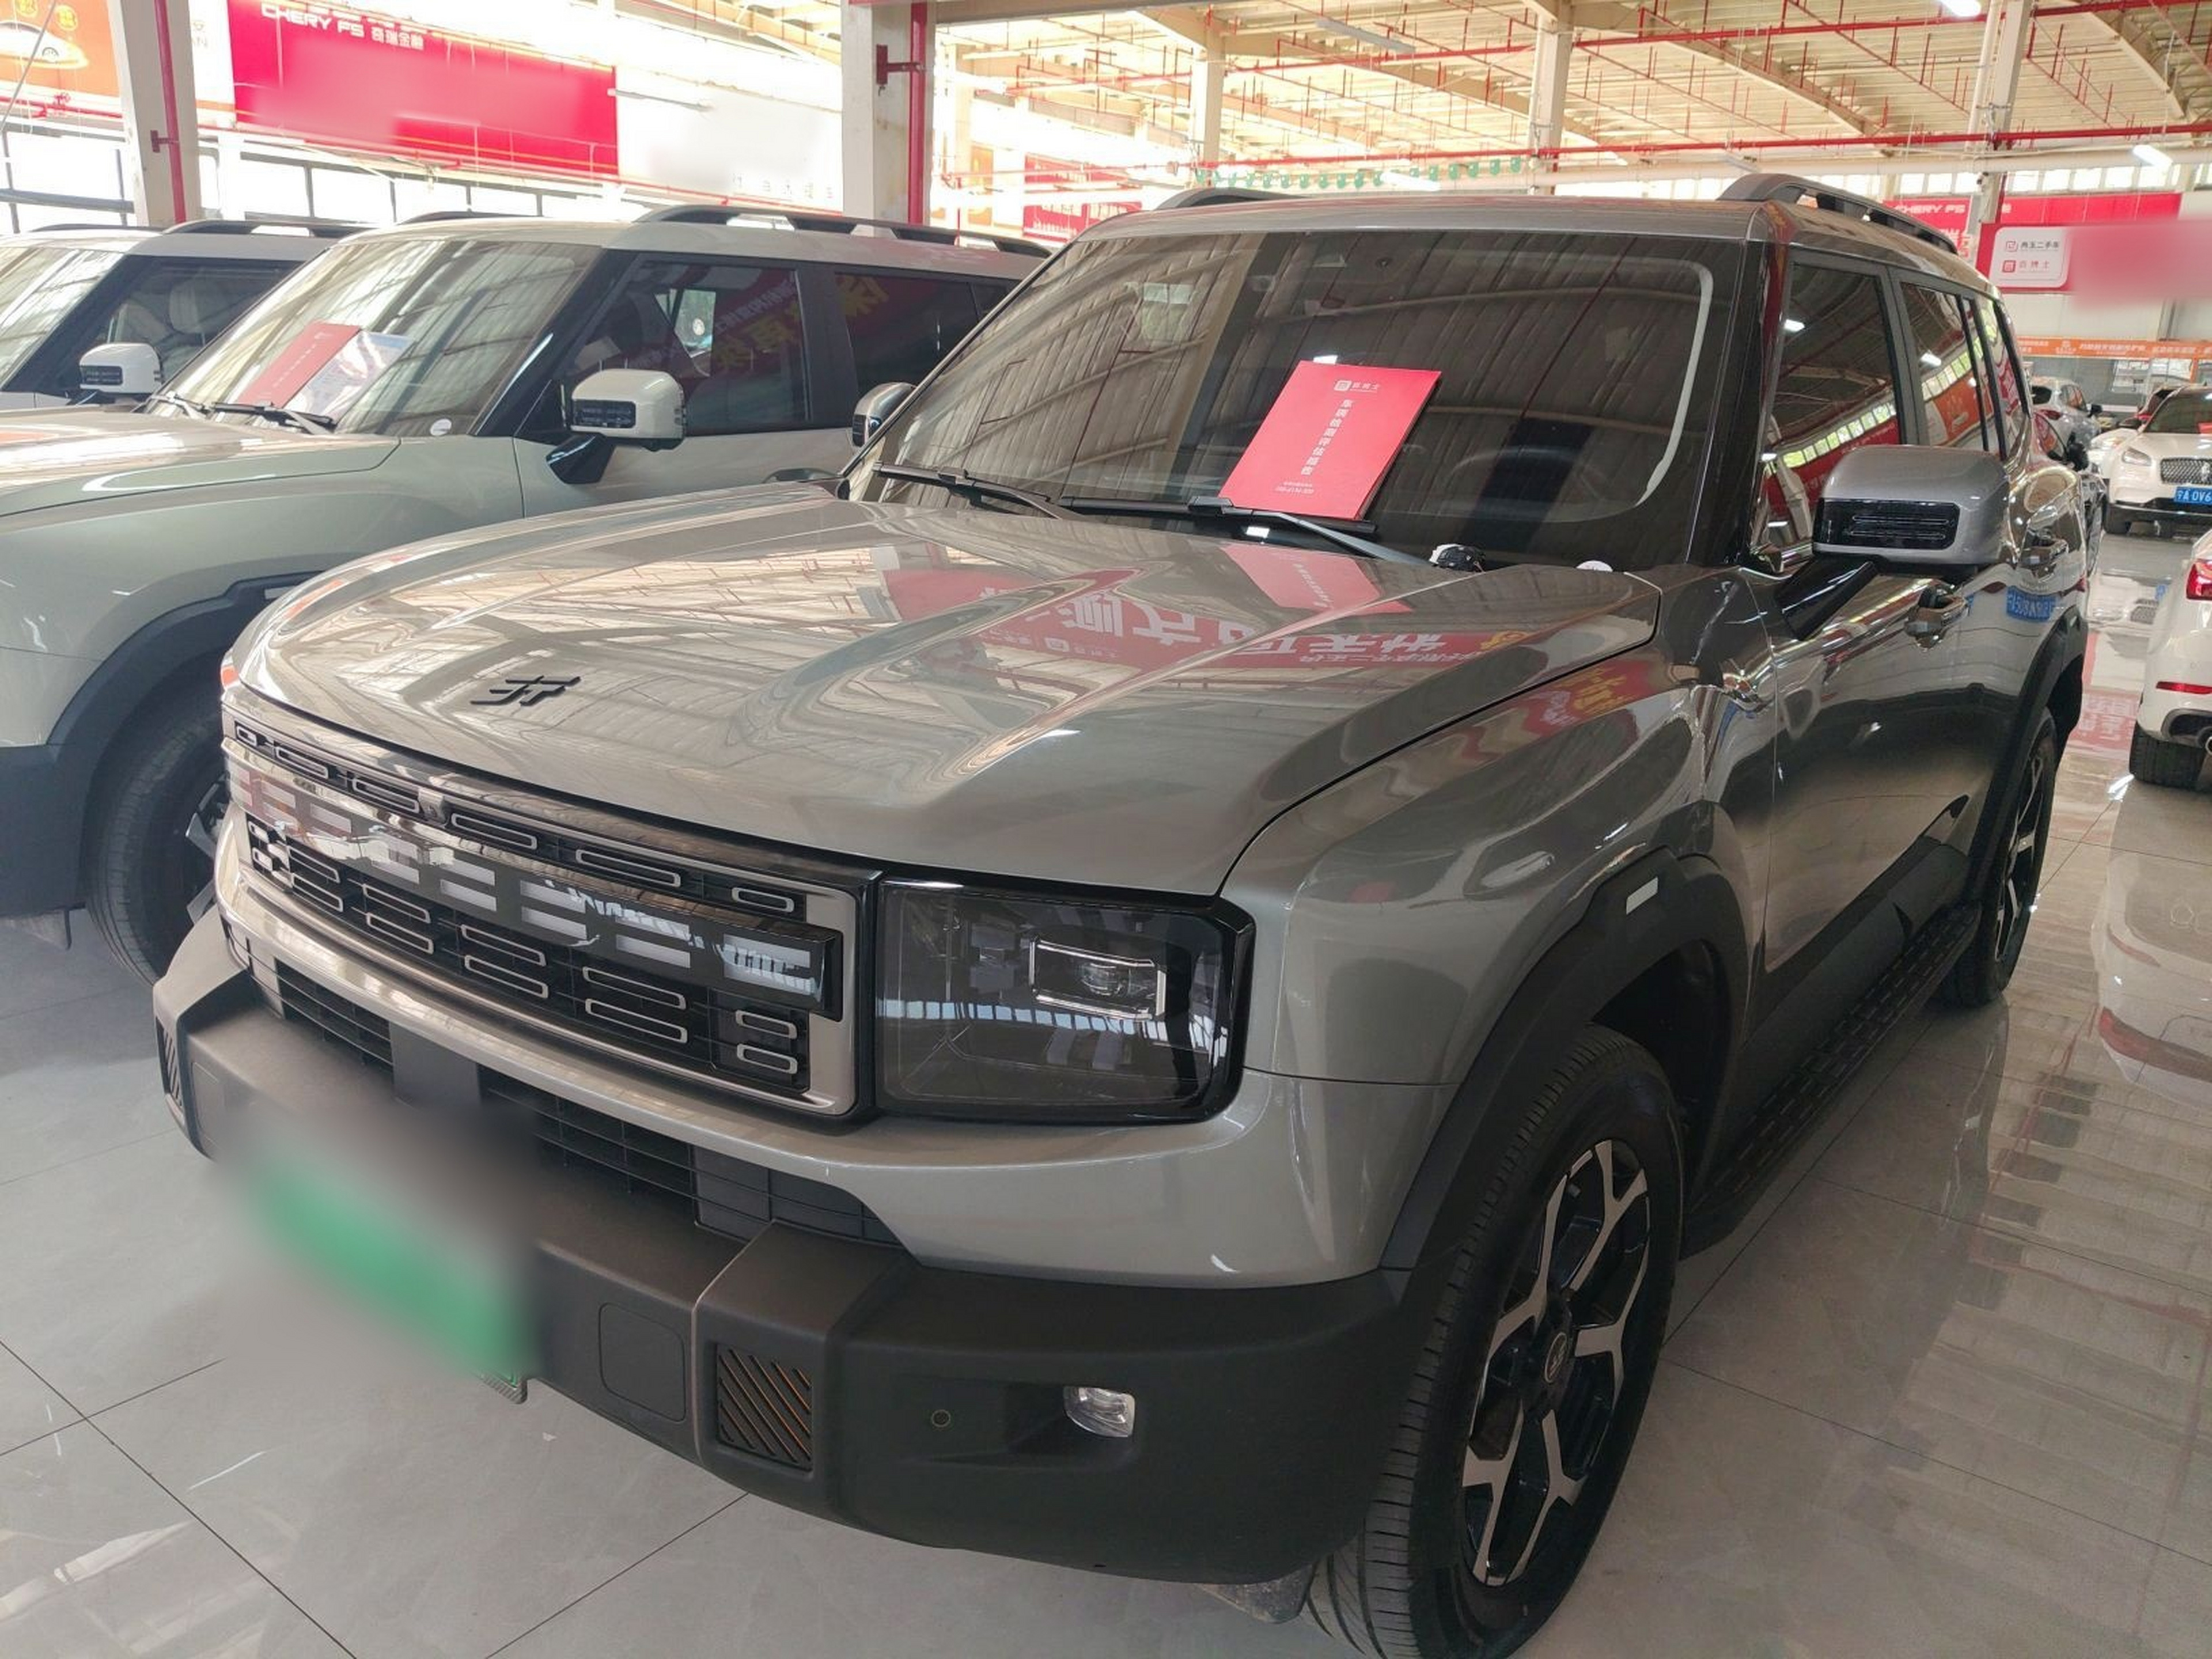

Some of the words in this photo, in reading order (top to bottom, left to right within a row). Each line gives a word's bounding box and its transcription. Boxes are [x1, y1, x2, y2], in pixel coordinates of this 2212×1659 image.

[261, 3, 332, 29] CHERY
[371, 26, 424, 51] 奇瑞金融
